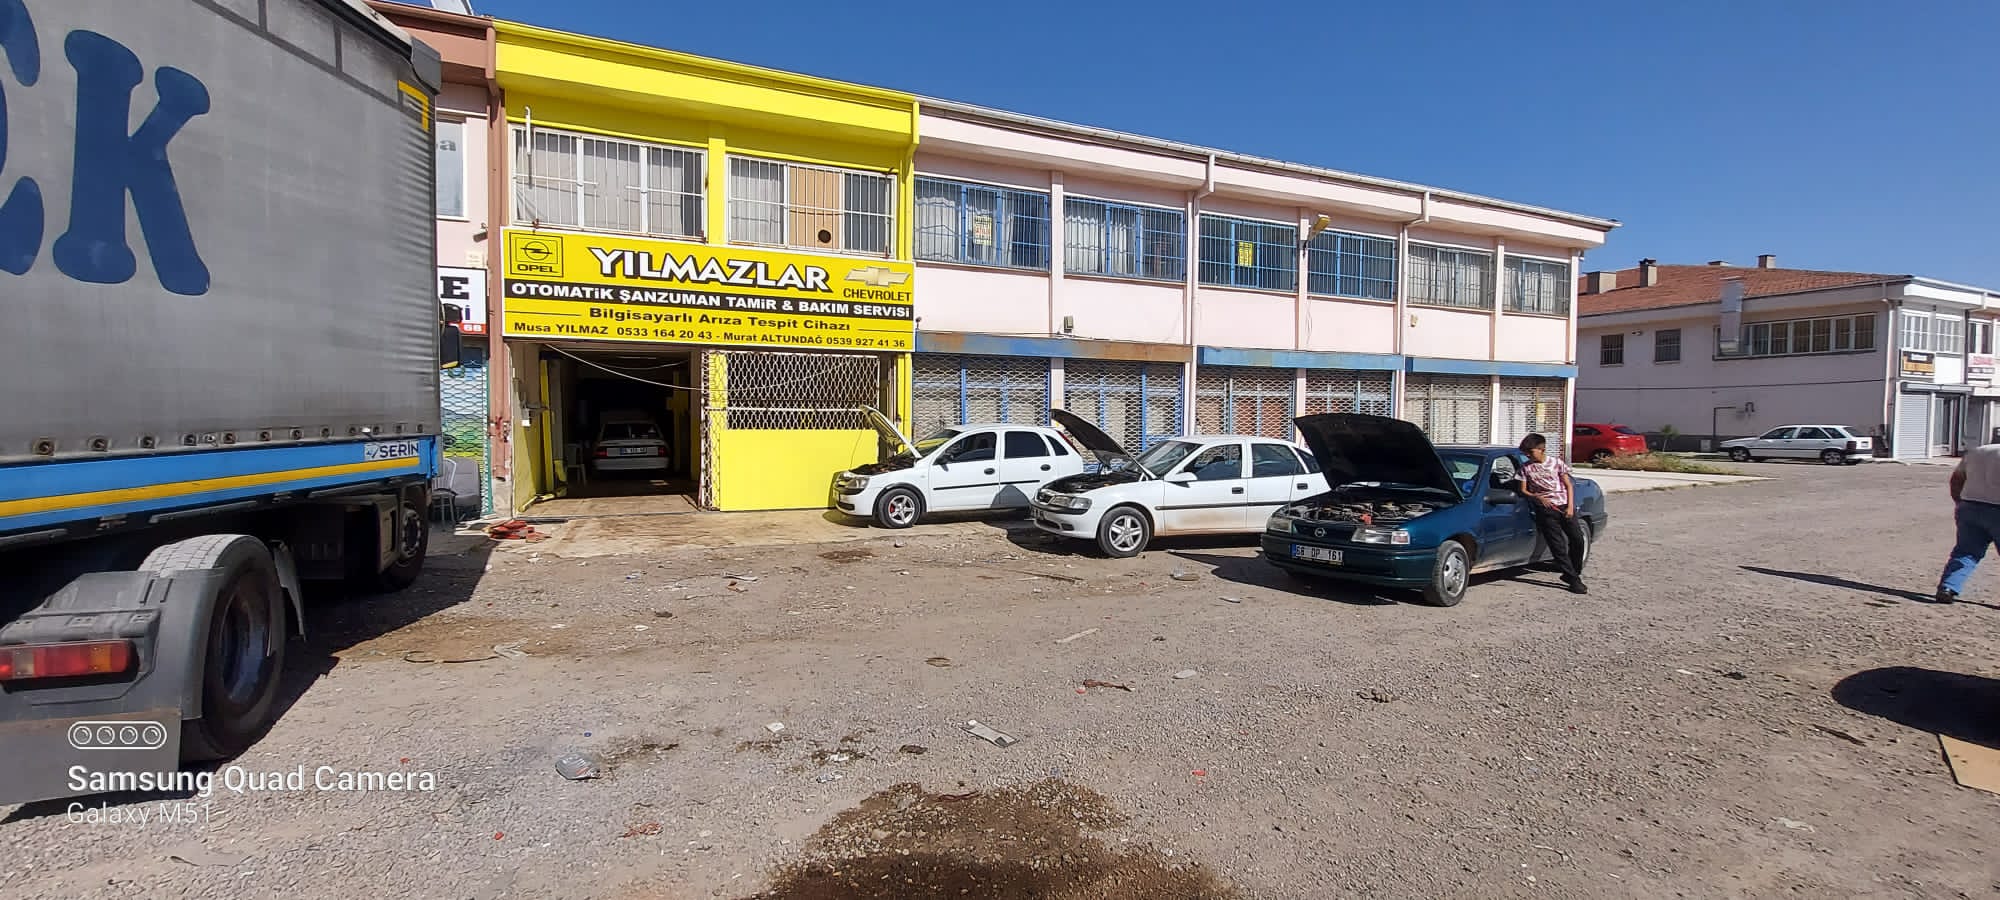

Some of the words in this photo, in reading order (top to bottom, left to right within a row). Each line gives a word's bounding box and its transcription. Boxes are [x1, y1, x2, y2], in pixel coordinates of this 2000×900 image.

[517, 263, 558, 274] OPEL
[588, 247, 832, 292] YILMAZLAR
[620, 289, 720, 307] ŞANZUMAN
[782, 300, 793, 311] &
[799, 301, 848, 314] BAKIM
[843, 288, 911, 302] CHEVROLET
[590, 308, 692, 323] Bilgisayarlı
[699, 313, 742, 326] Arıza
[748, 317, 798, 330] Tespit
[804, 319, 850, 331] Cihazı
[514, 322, 551, 332] Musa
[556, 324, 608, 335] YILMAZ
[617, 327, 648, 337] 0533
[653, 329, 675, 338] 164
[679, 330, 694, 339] 20
[698, 331, 712, 339] 43
[724, 332, 757, 342] Murat
[761, 334, 822, 345] ALTUNDAĞ
[827, 337, 851, 346] 0539
[856, 338, 874, 347] 927
[877, 339, 889, 347] 41
[893, 340, 905, 348] 36
